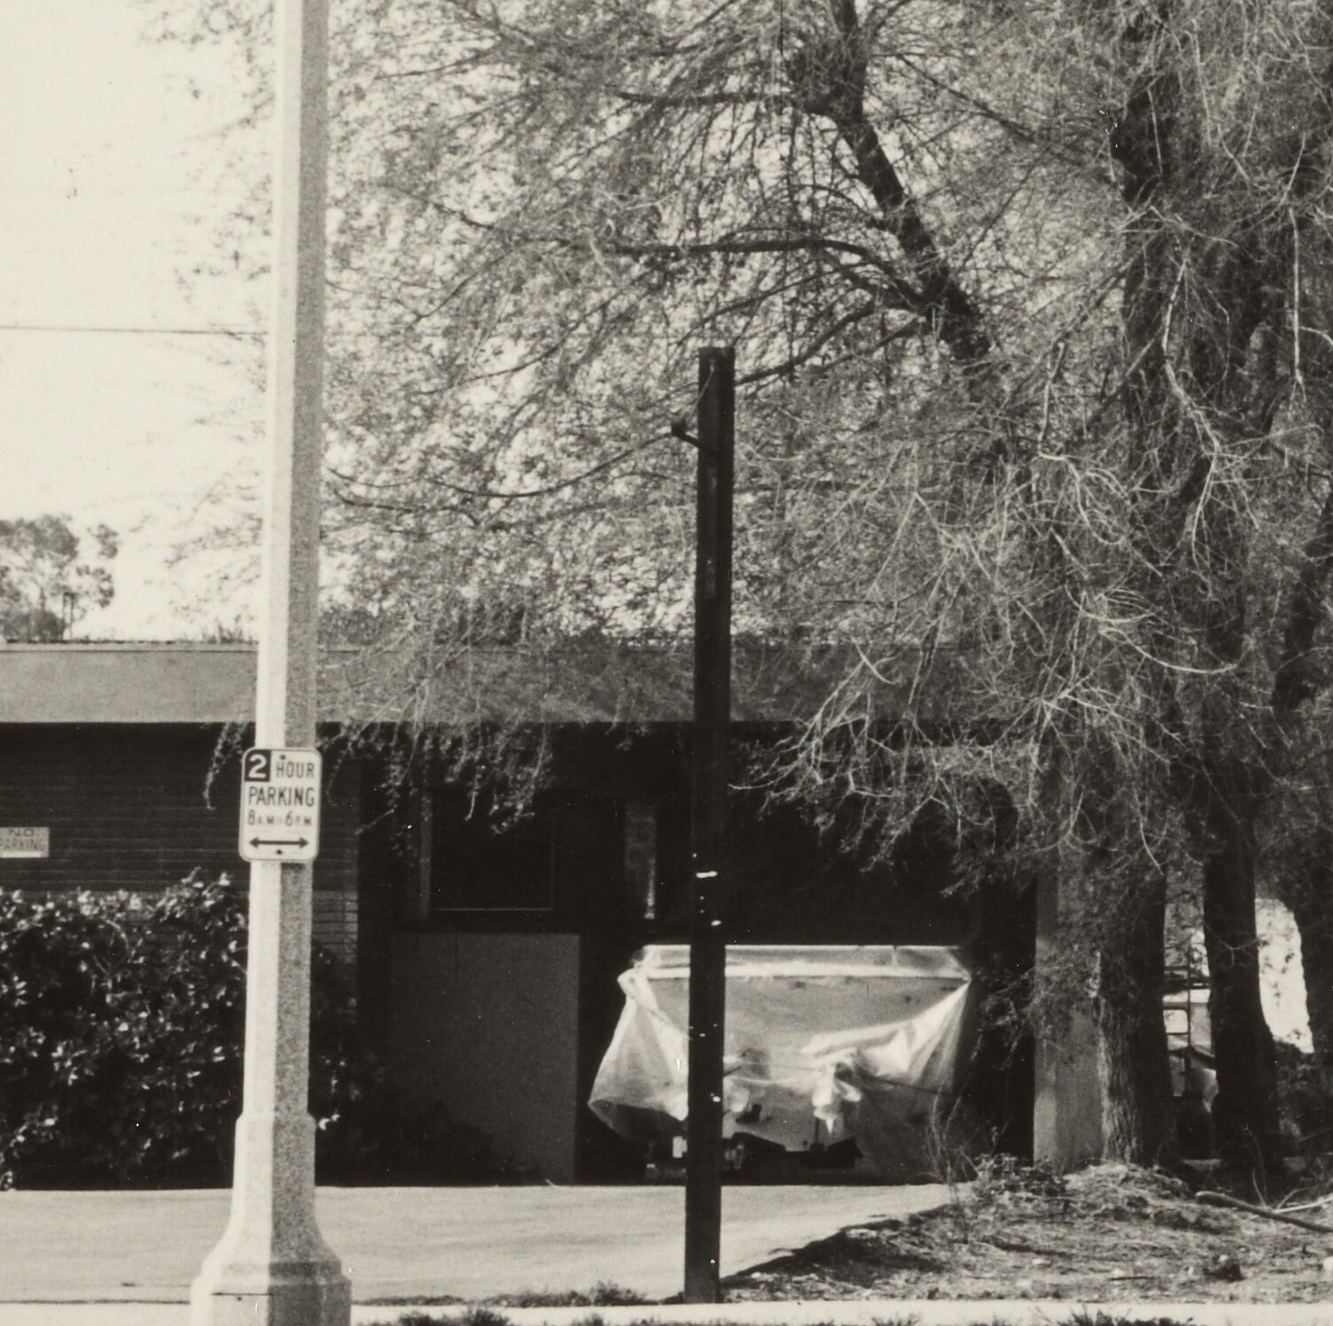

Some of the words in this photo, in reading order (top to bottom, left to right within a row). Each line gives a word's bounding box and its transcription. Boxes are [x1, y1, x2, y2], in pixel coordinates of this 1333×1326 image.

[248, 754, 267, 779] 2
[276, 761, 315, 779] HOUR
[248, 786, 315, 807] PARKING
